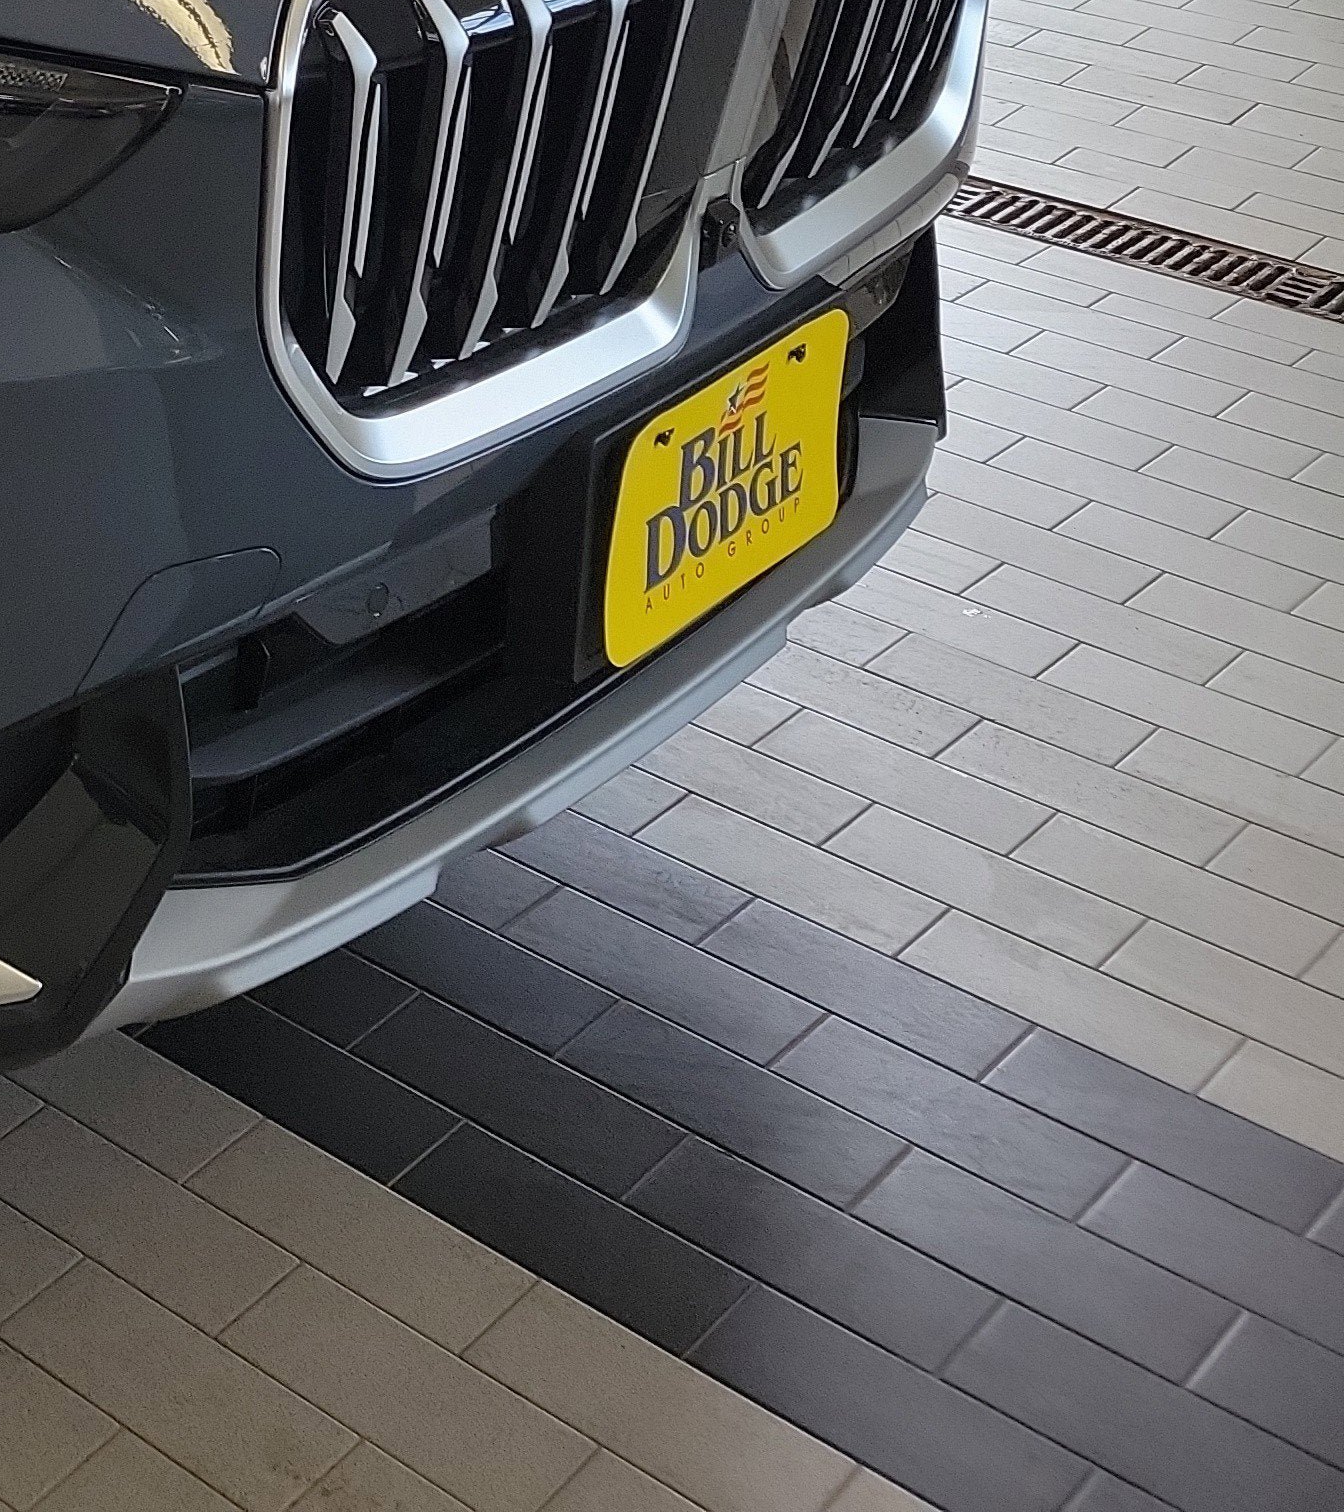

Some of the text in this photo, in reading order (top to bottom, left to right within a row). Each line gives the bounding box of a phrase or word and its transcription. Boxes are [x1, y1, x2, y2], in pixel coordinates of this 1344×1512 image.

[643, 441, 804, 595] DODGE
[679, 410, 777, 509] BILL
[644, 497, 801, 614] AUTO GROUP
